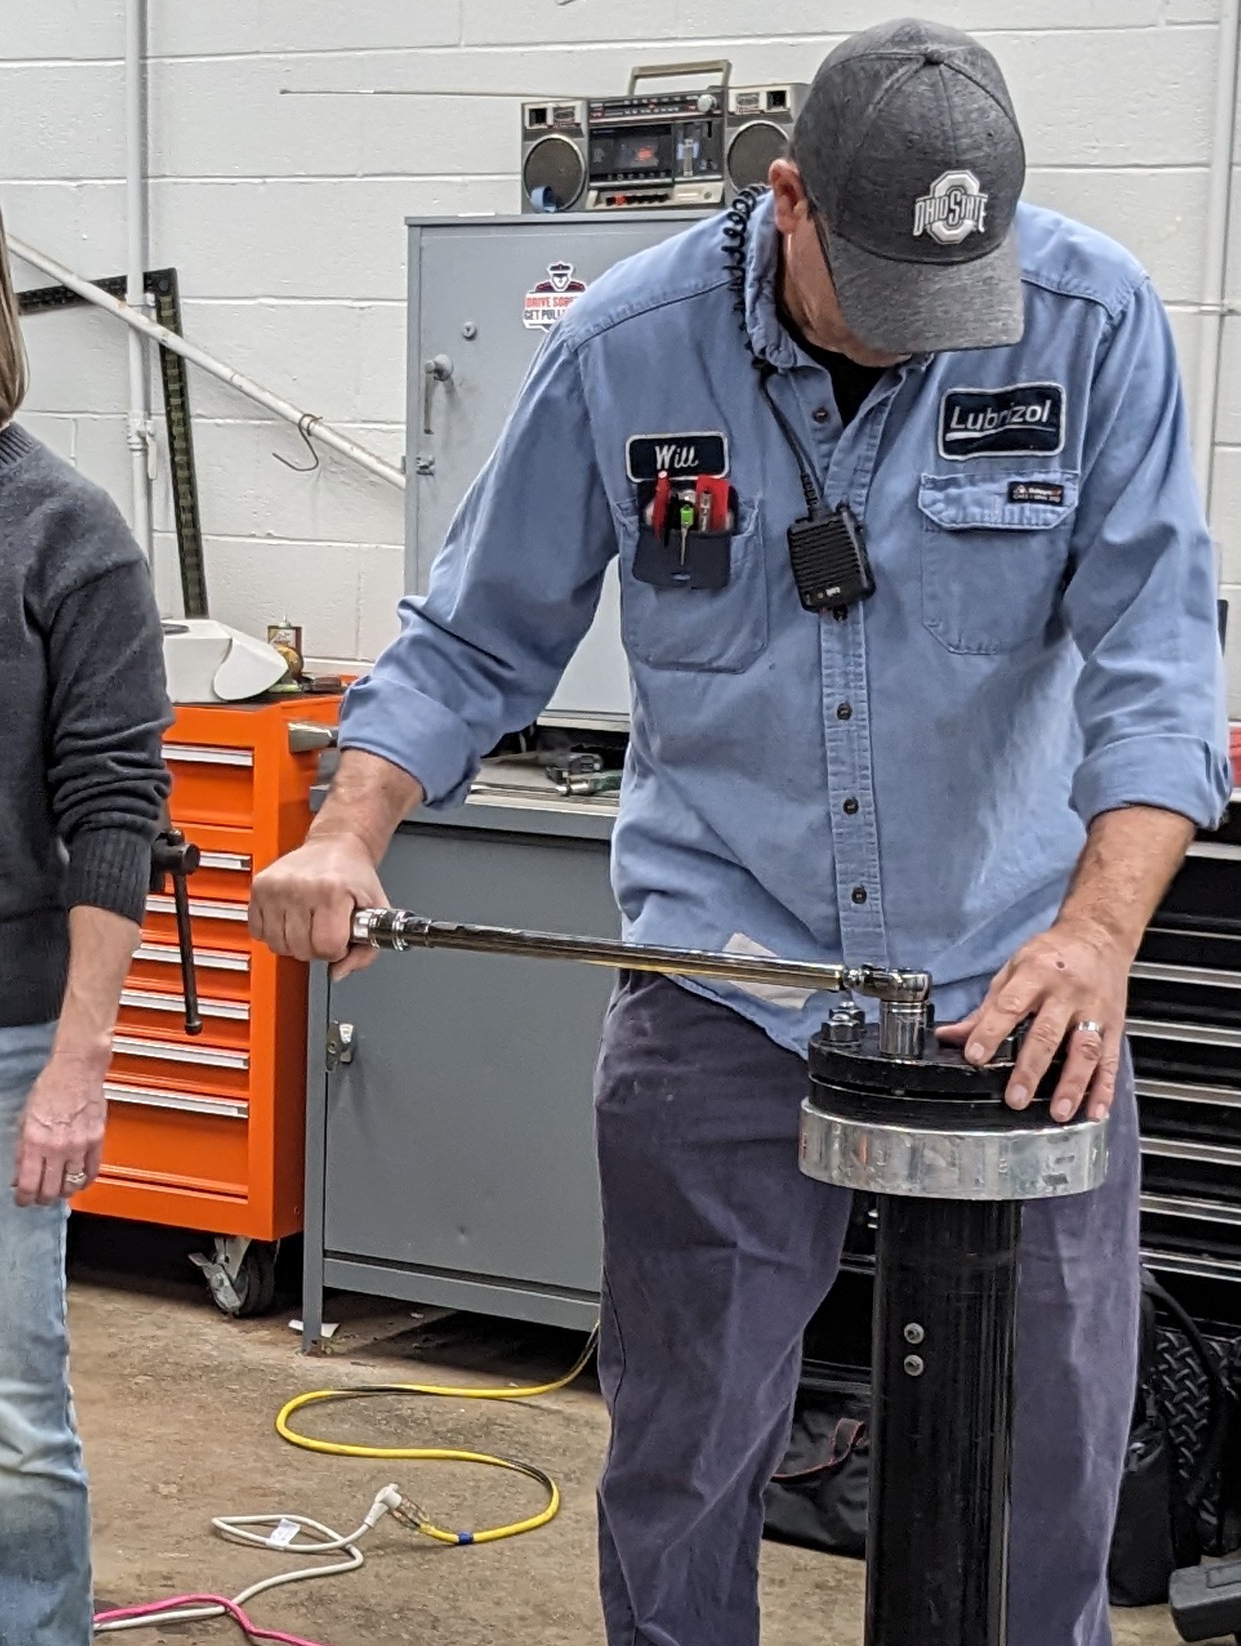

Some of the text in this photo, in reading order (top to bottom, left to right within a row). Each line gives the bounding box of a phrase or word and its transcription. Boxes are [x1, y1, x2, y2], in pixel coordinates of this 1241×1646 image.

[525, 296, 578, 308] DRIVE SOBE
[524, 309, 540, 320] GET
[950, 399, 1051, 431] Lubrizol
[655, 444, 699, 470] Will
